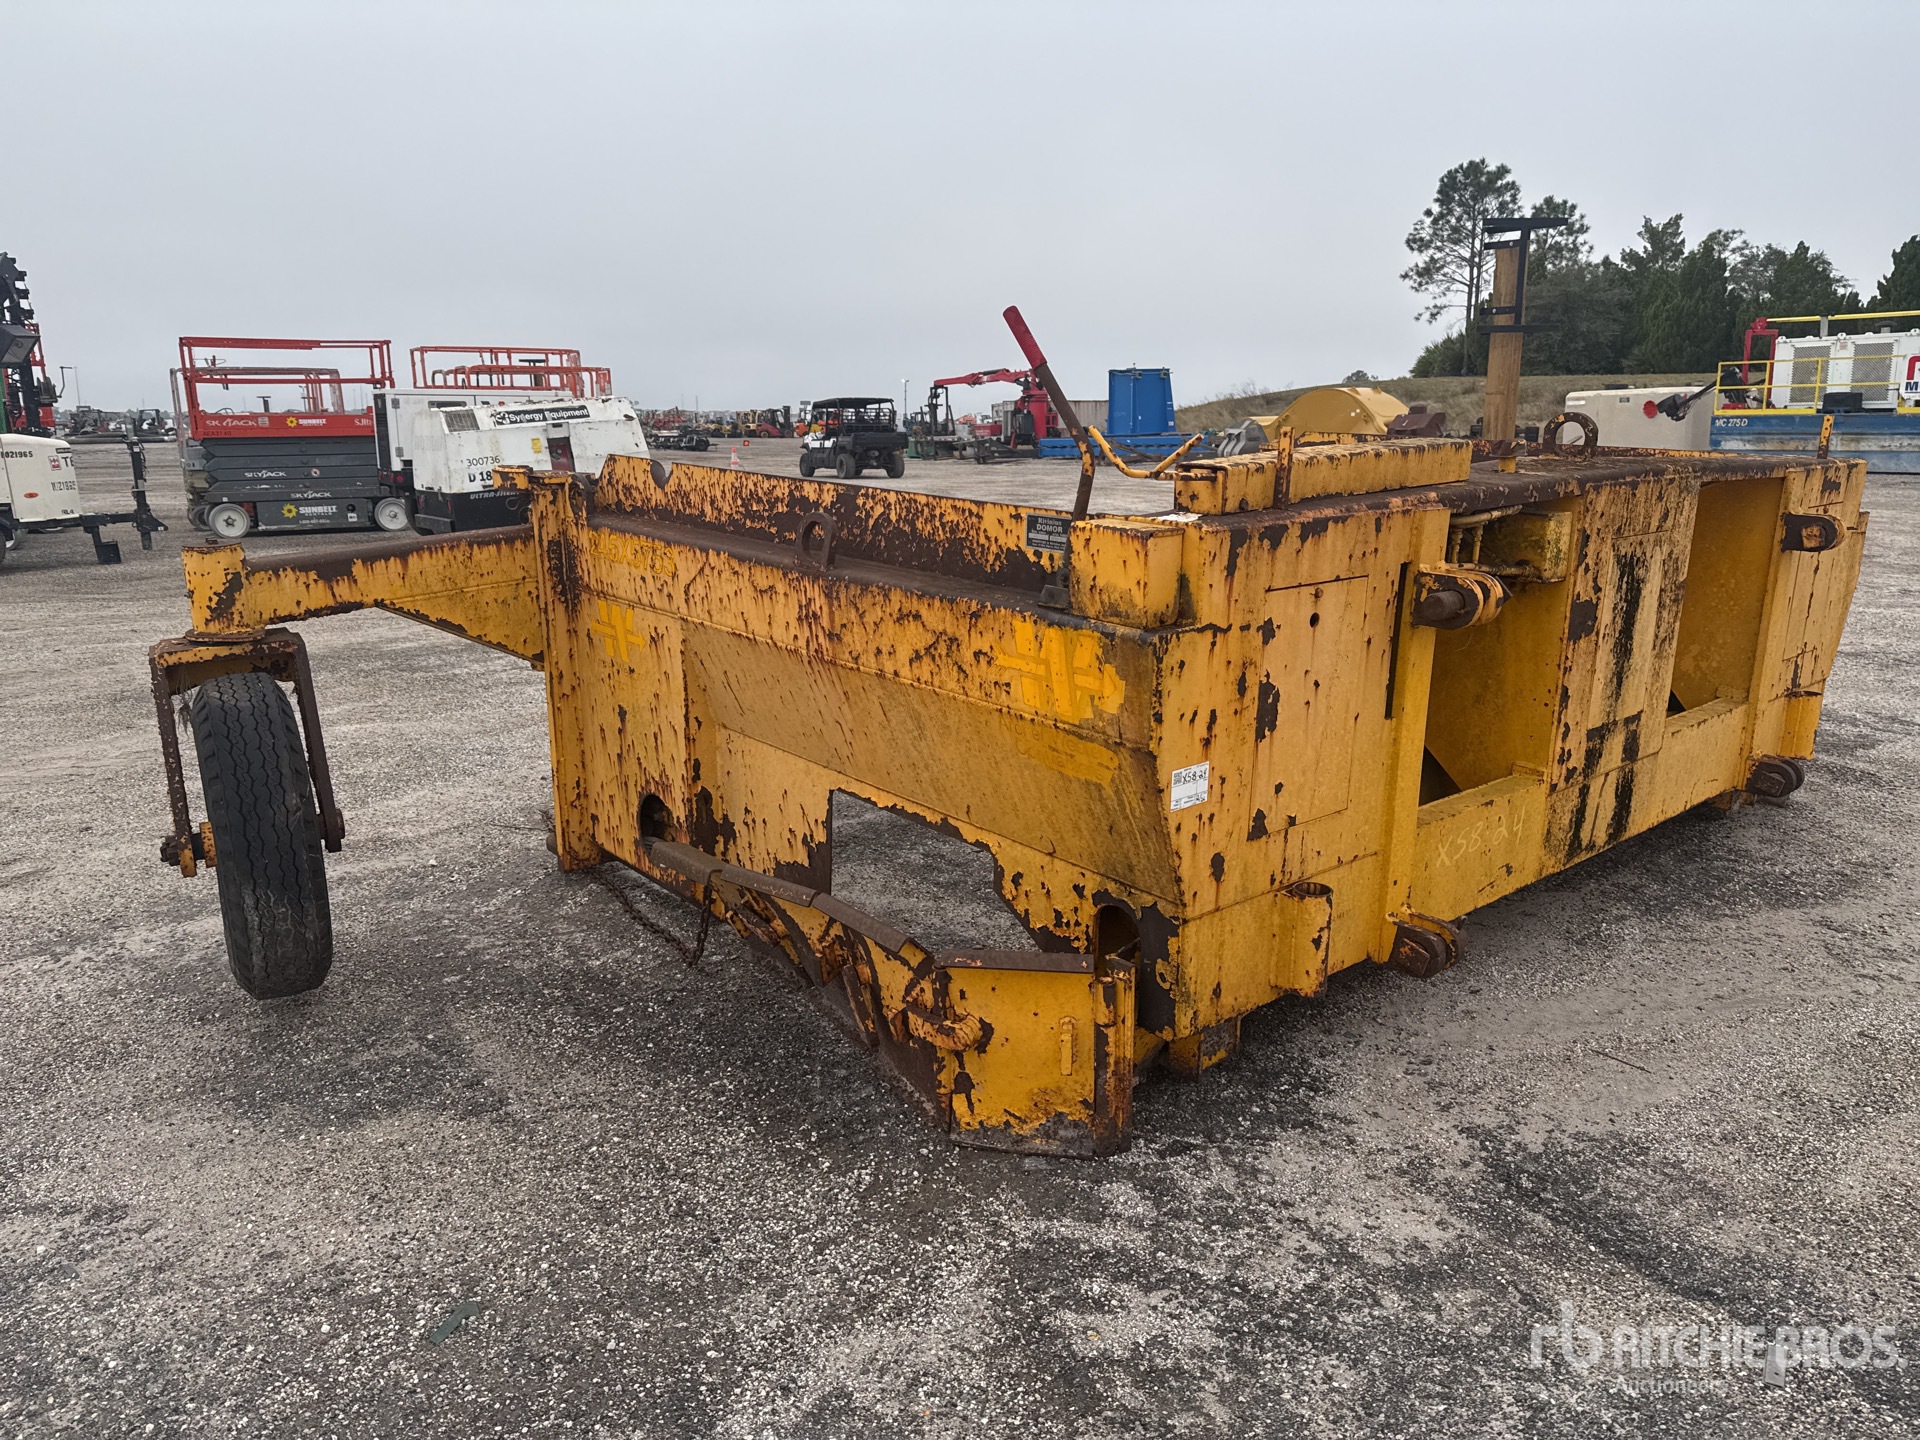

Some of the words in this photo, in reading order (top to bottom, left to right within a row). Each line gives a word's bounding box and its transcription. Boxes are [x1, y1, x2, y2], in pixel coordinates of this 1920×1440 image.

[509, 412, 543, 423] Synergy
[466, 455, 501, 467] 300736
[298, 505, 339, 514] SUNBELT
[1036, 523, 1064, 533] DOMOR
